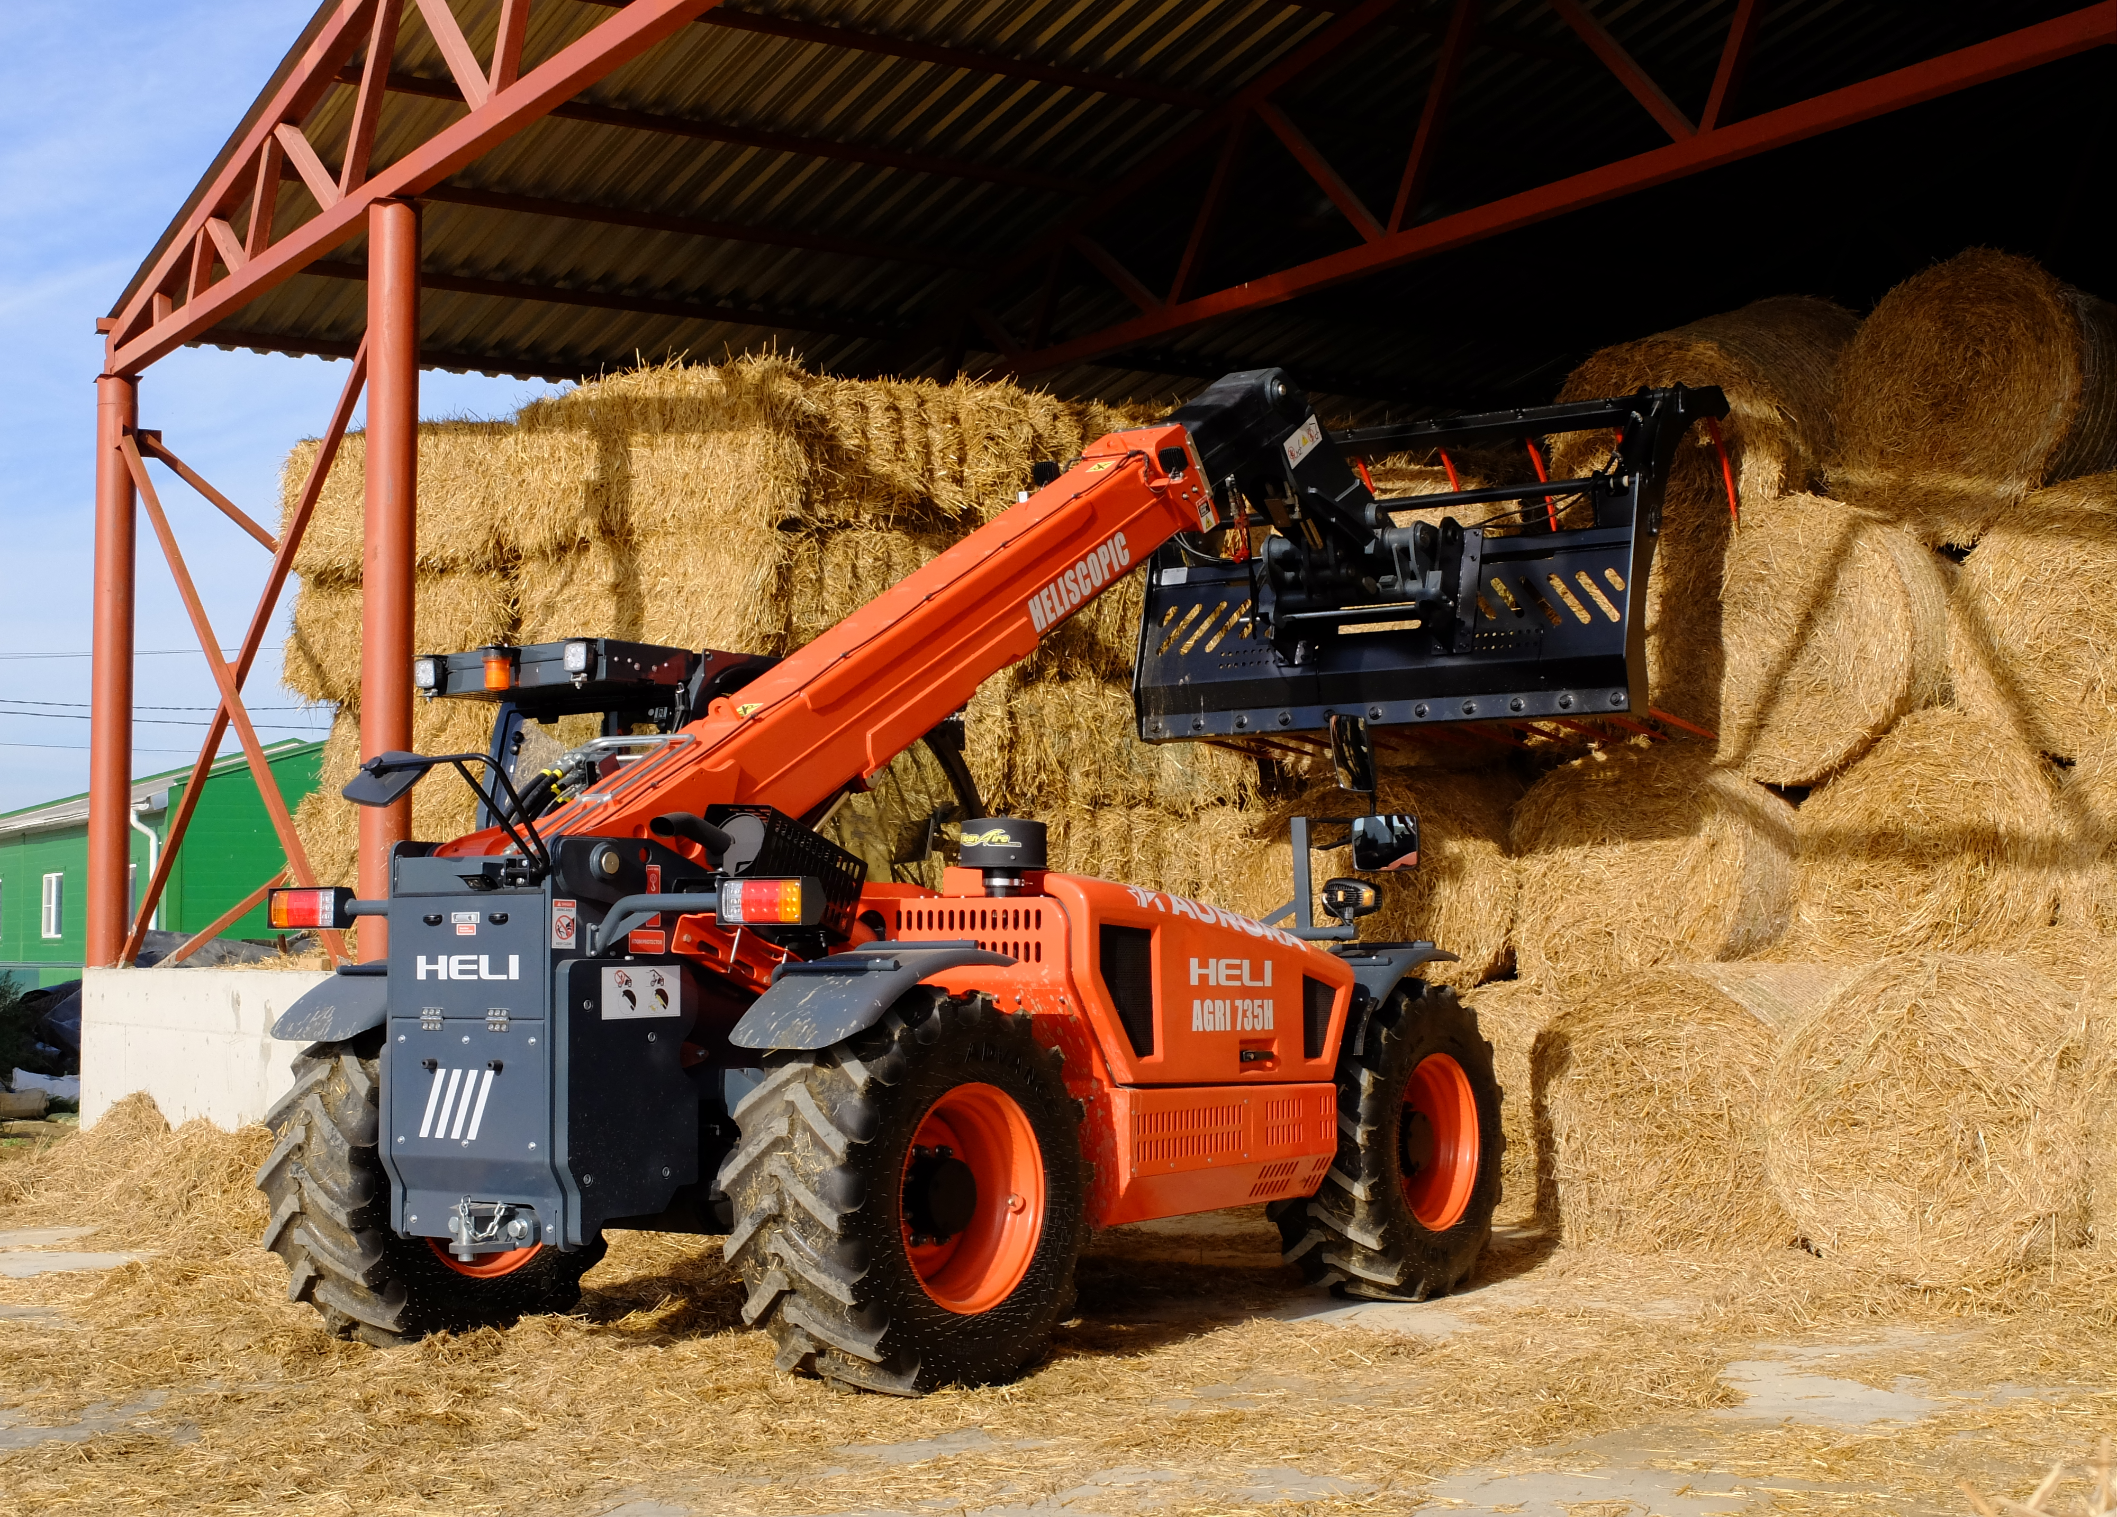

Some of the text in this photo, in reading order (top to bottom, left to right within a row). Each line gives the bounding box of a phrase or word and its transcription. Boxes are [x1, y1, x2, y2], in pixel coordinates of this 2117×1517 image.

[1027, 531, 1130, 634] HELISCOPIC
[1168, 893, 1307, 951] AURORA
[416, 954, 519, 980] HELI
[1189, 957, 1273, 987] HELI
[1191, 999, 1274, 1032] AGRI 735H
